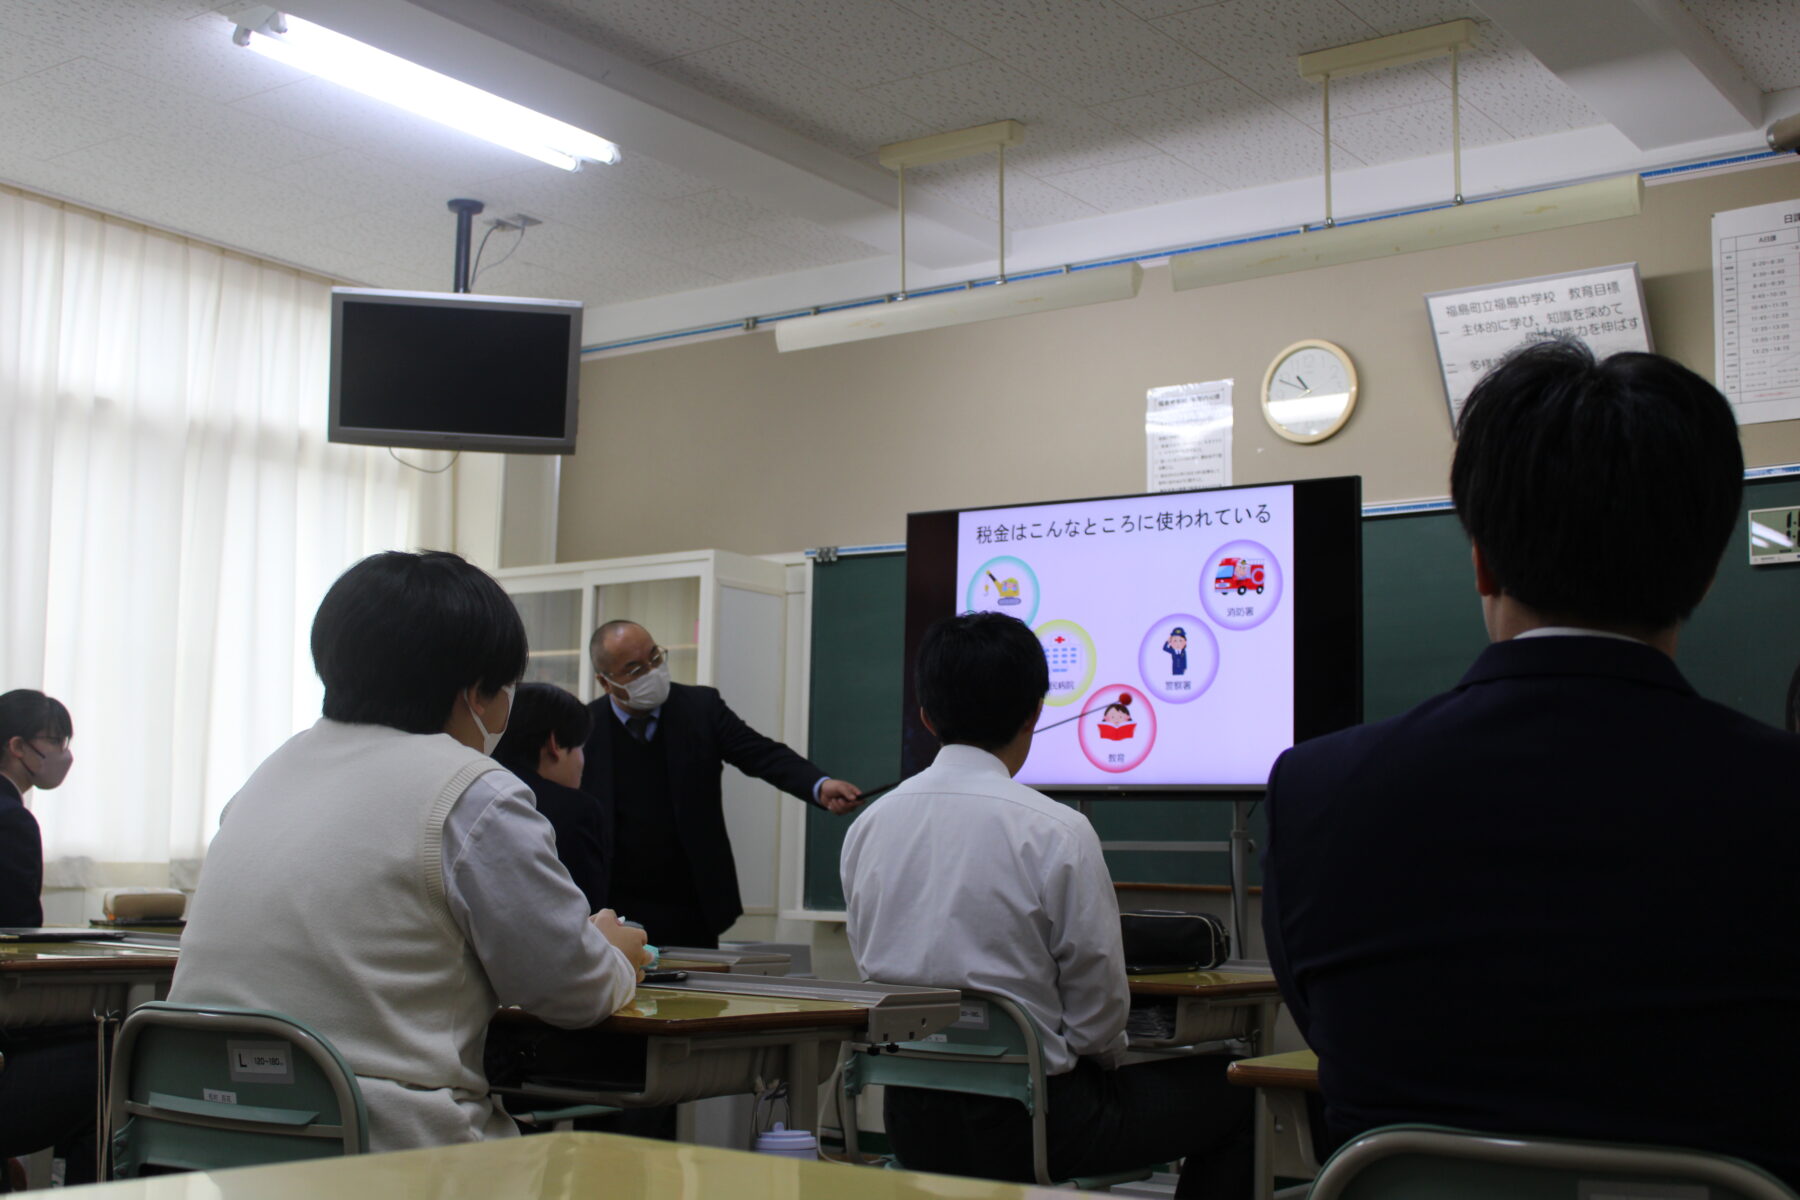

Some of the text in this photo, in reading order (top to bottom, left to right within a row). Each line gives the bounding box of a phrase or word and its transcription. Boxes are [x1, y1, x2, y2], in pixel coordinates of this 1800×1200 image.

[1445, 281, 1621, 317] 福島町立福島中学校 教育目標
[976, 503, 1271, 545] 税金はこんなところに使われている
[238, 1053, 247, 1068] L
